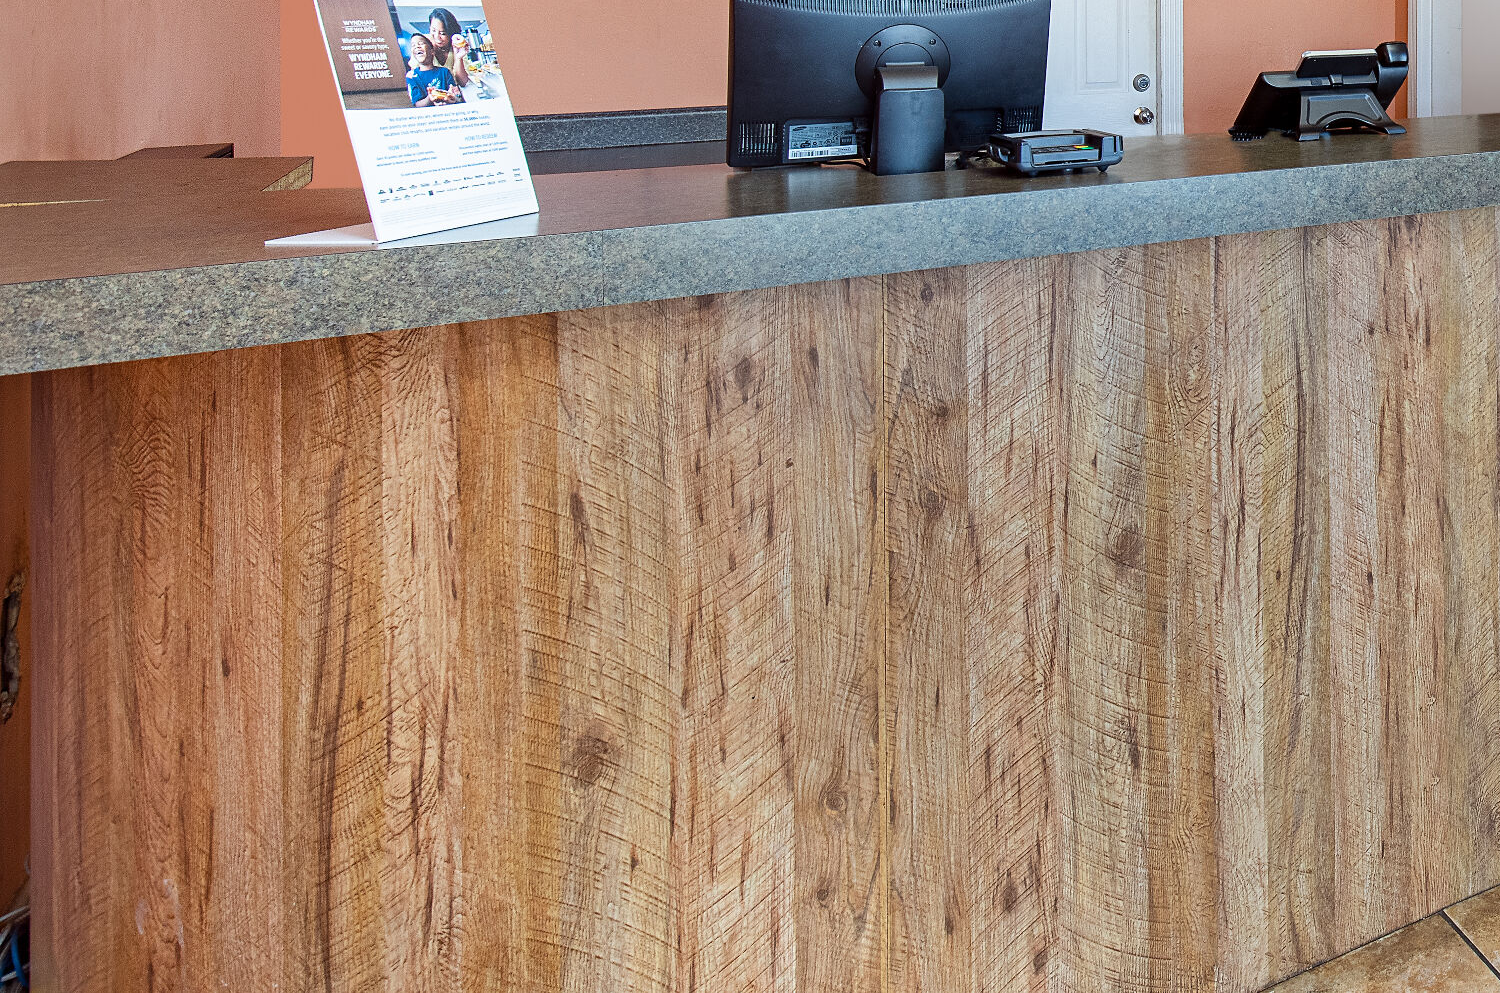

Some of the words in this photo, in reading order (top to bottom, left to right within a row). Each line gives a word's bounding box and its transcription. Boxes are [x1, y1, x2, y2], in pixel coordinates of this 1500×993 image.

[348, 52, 387, 62] WYNDHAM
[353, 61, 388, 70] REWARDS
[354, 69, 393, 80] EVERYONE.
